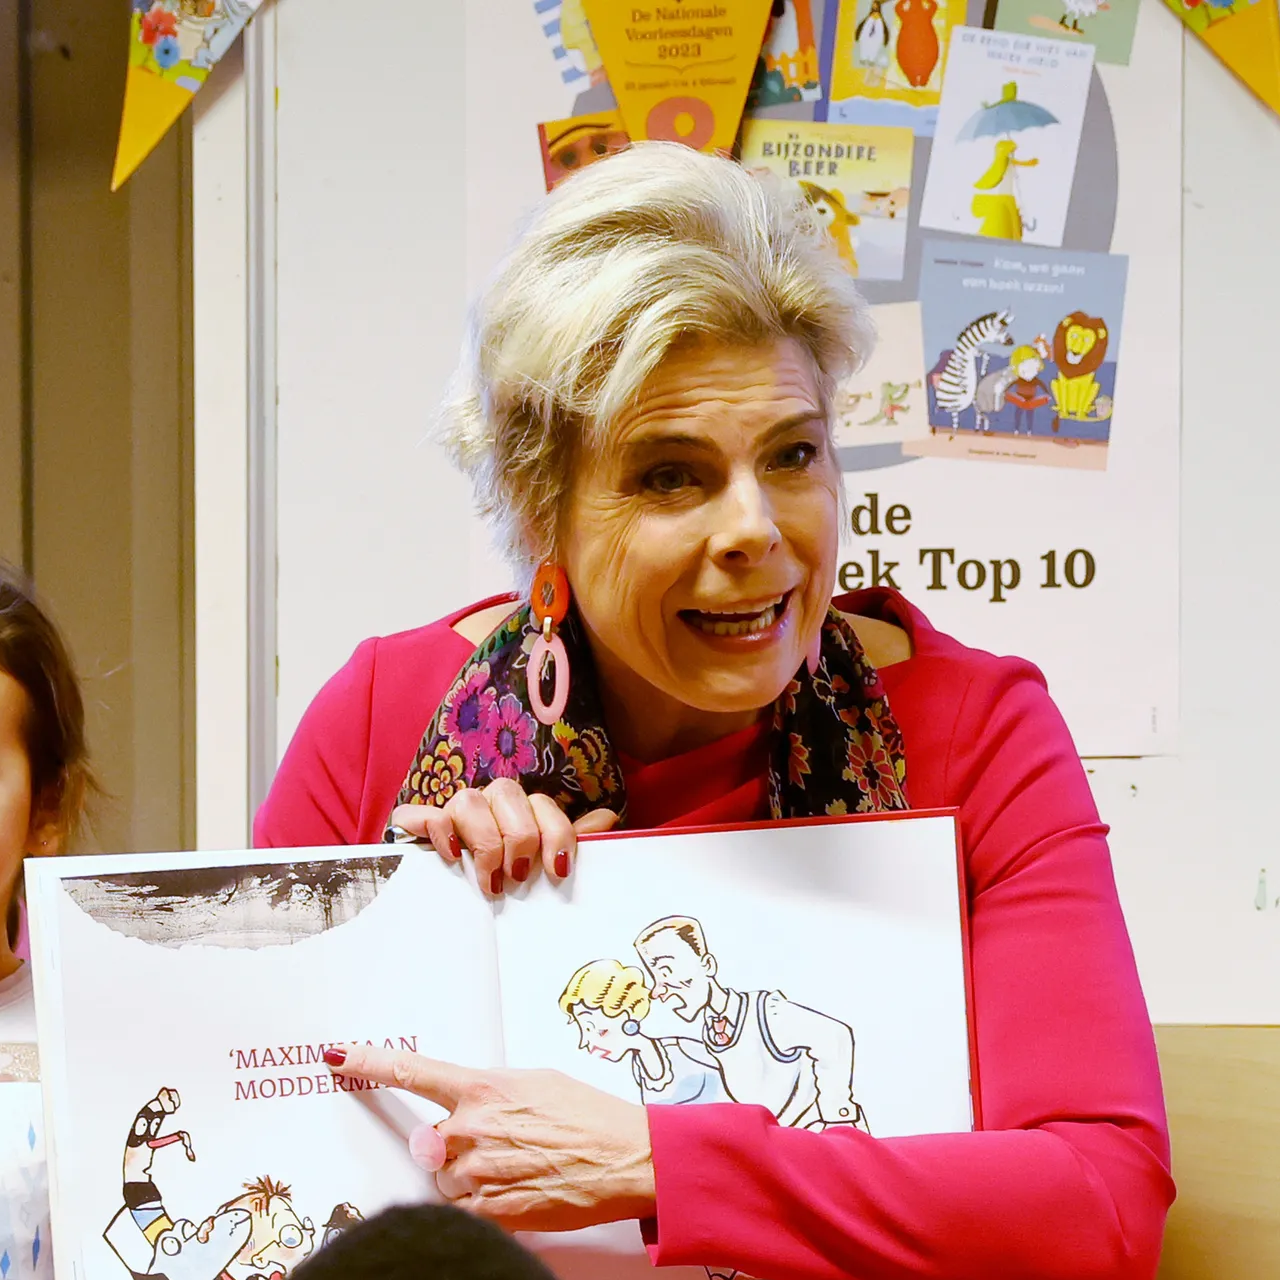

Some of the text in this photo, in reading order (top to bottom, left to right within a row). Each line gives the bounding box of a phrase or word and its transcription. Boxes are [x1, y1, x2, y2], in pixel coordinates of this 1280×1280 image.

[631, 5, 727, 23] De Nationale
[625, 25, 734, 42] Voorleesdagen
[657, 43, 702, 59] 2023
[788, 159, 839, 177] BEER
[851, 492, 912, 537] de
[838, 548, 1097, 604] ek Top 10
[229, 1035, 418, 1069] ‘MAXIMN
[234, 1073, 392, 1101] MODDERM
